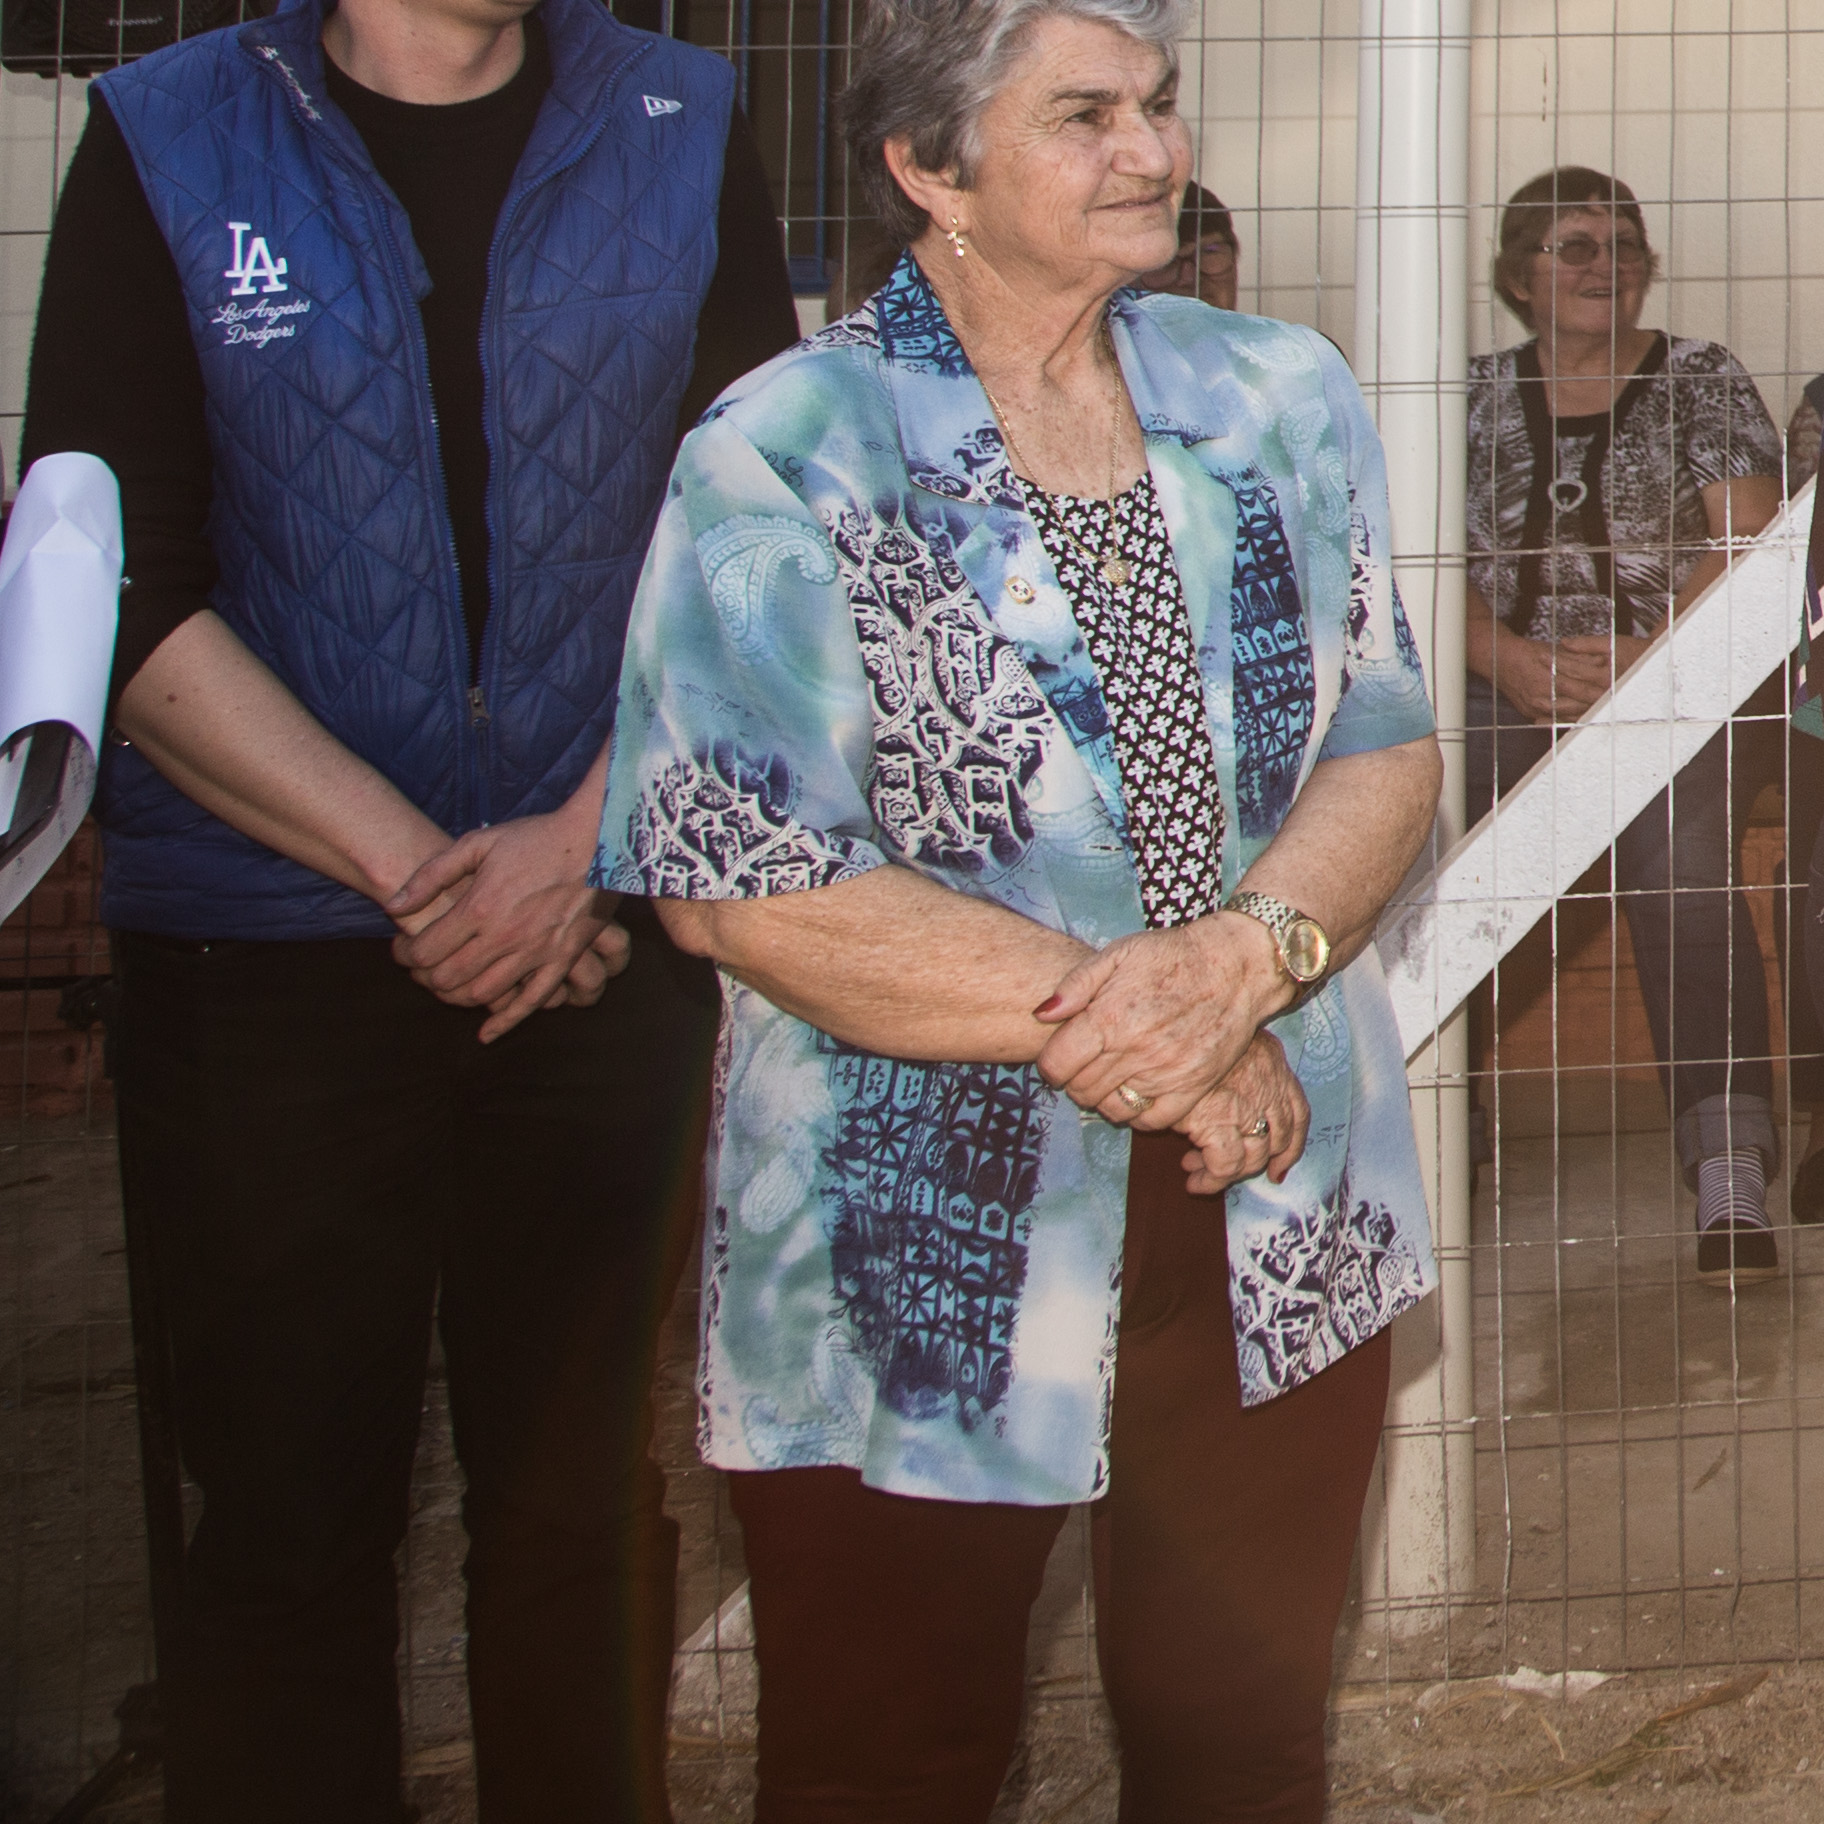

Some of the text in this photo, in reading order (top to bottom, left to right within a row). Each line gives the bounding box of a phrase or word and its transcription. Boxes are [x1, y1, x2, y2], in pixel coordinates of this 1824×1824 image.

[224, 221, 289, 297] LA
[243, 297, 312, 326] Angeles
[223, 323, 297, 350] Dodgers
